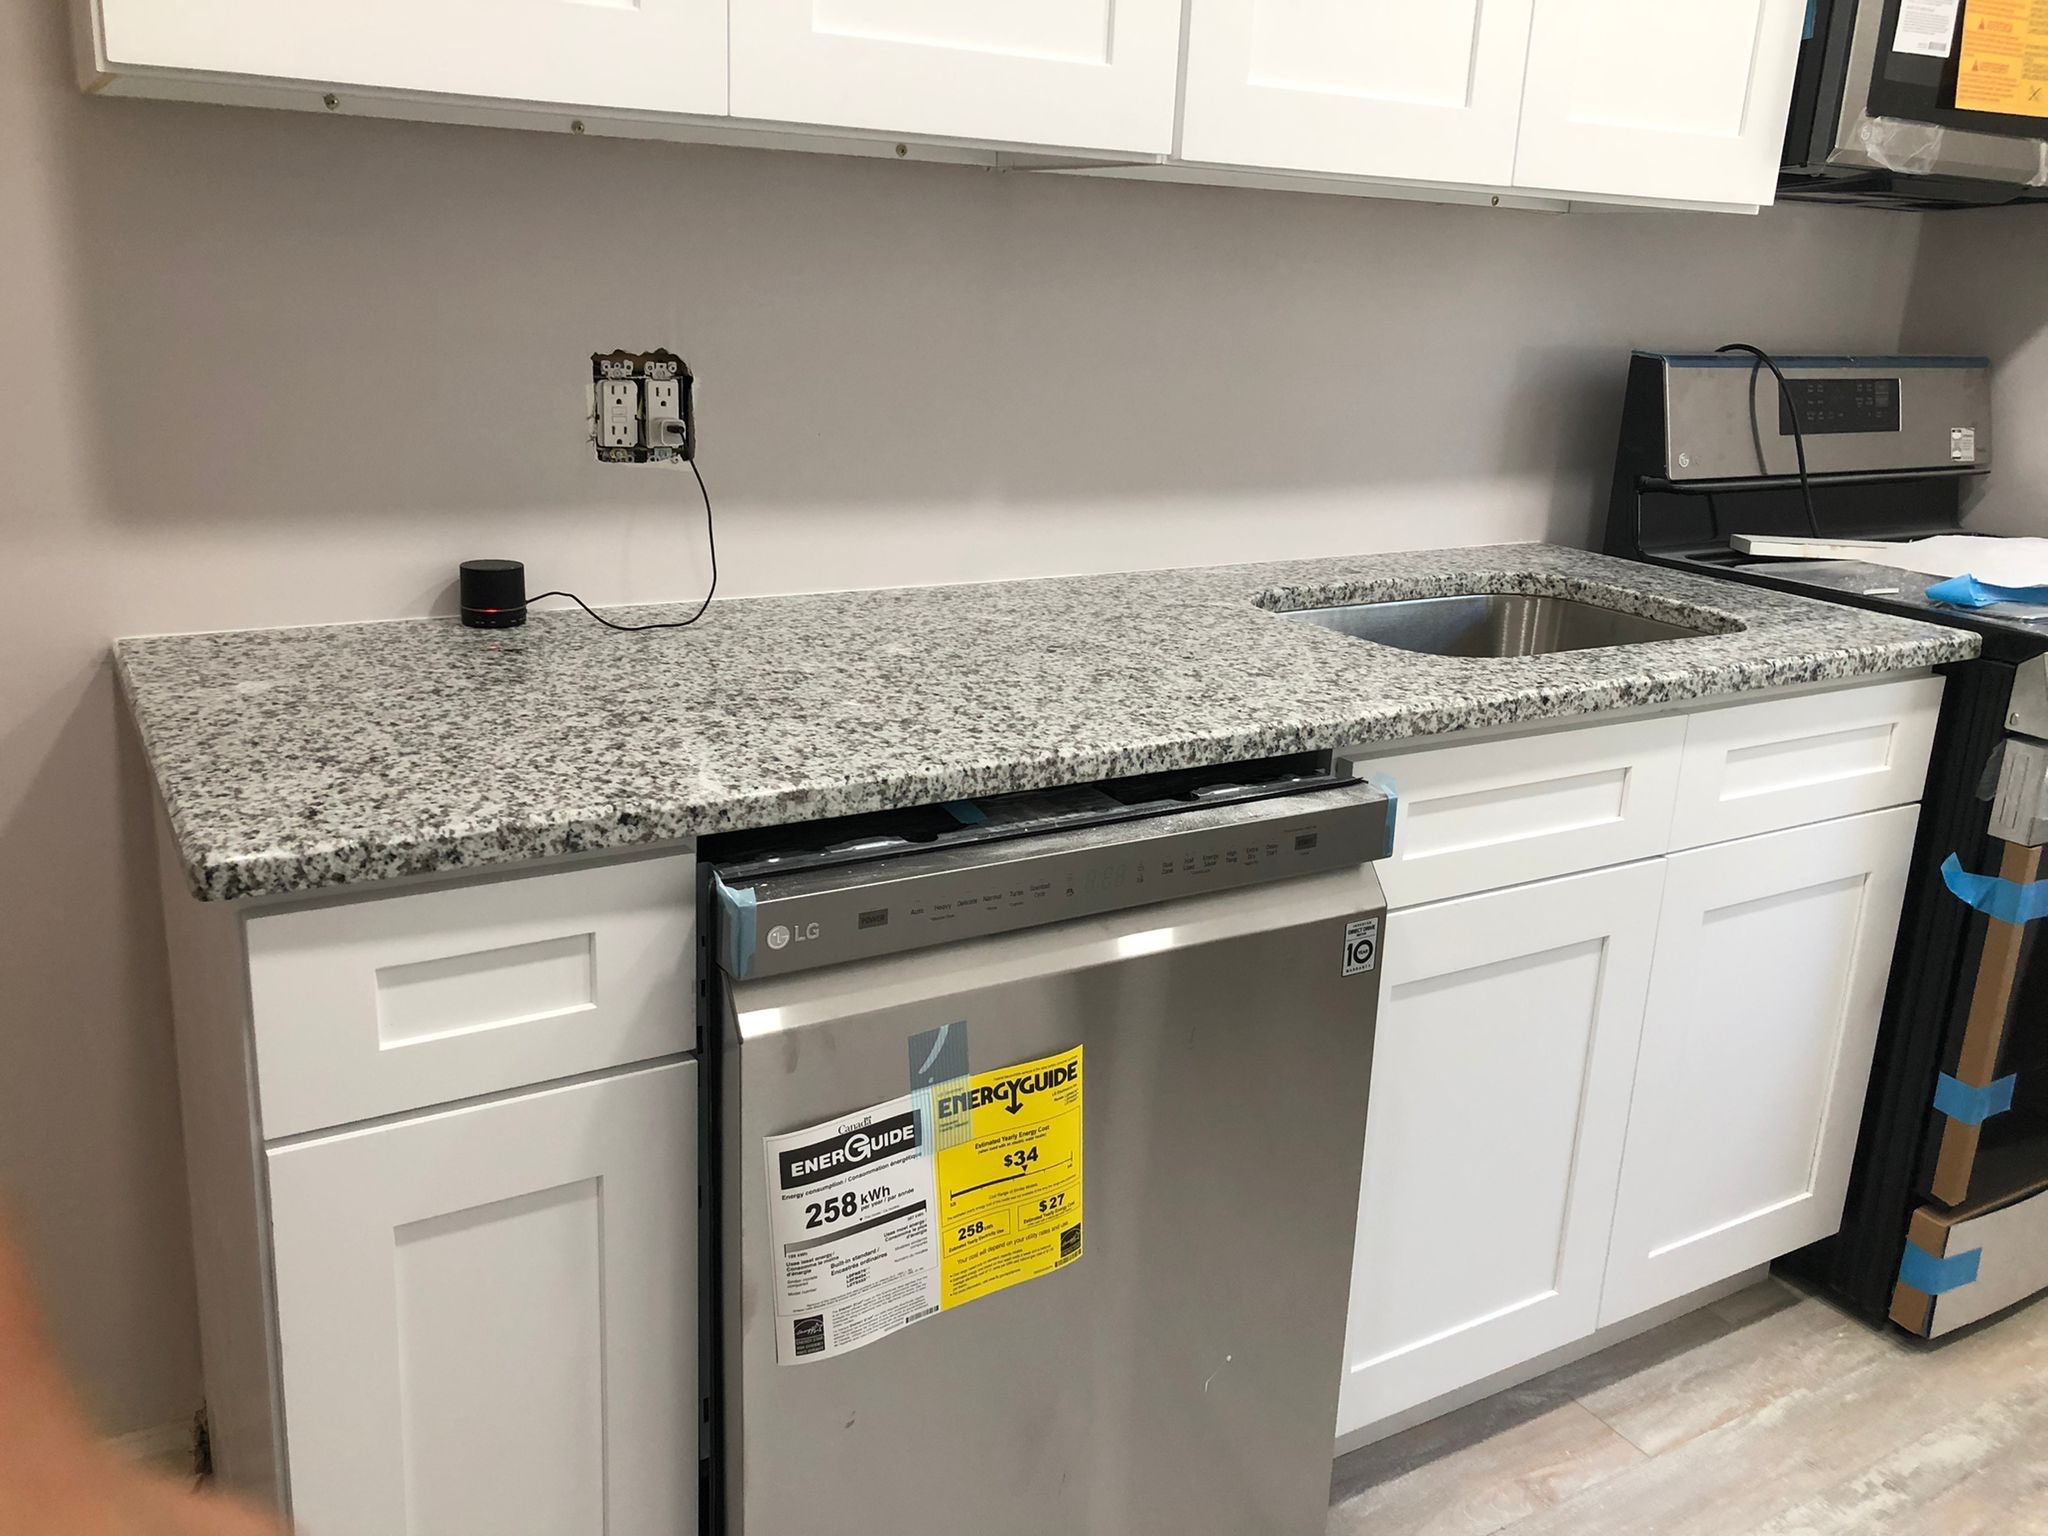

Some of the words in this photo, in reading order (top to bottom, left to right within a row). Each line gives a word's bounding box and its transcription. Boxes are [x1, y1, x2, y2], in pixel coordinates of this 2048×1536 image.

[794, 922, 820, 942] LG
[1347, 939, 1374, 967] 10
[938, 1060, 1078, 1119] ENERGYGUIDE
[837, 1116, 872, 1135] Canada
[790, 1125, 915, 1177] ENERGUIDE
[975, 1137, 1001, 1150] Estimated
[1002, 1132, 1018, 1143] Yearly
[1018, 1127, 1037, 1139] Energy
[1003, 1146, 1039, 1168] $34
[781, 1191, 804, 1200] Energy
[805, 1180, 844, 1195] consumption
[848, 1165, 889, 1182] Consommation
[805, 1192, 858, 1229] 258
[860, 1186, 891, 1205] kWh
[958, 1221, 984, 1241] 258
